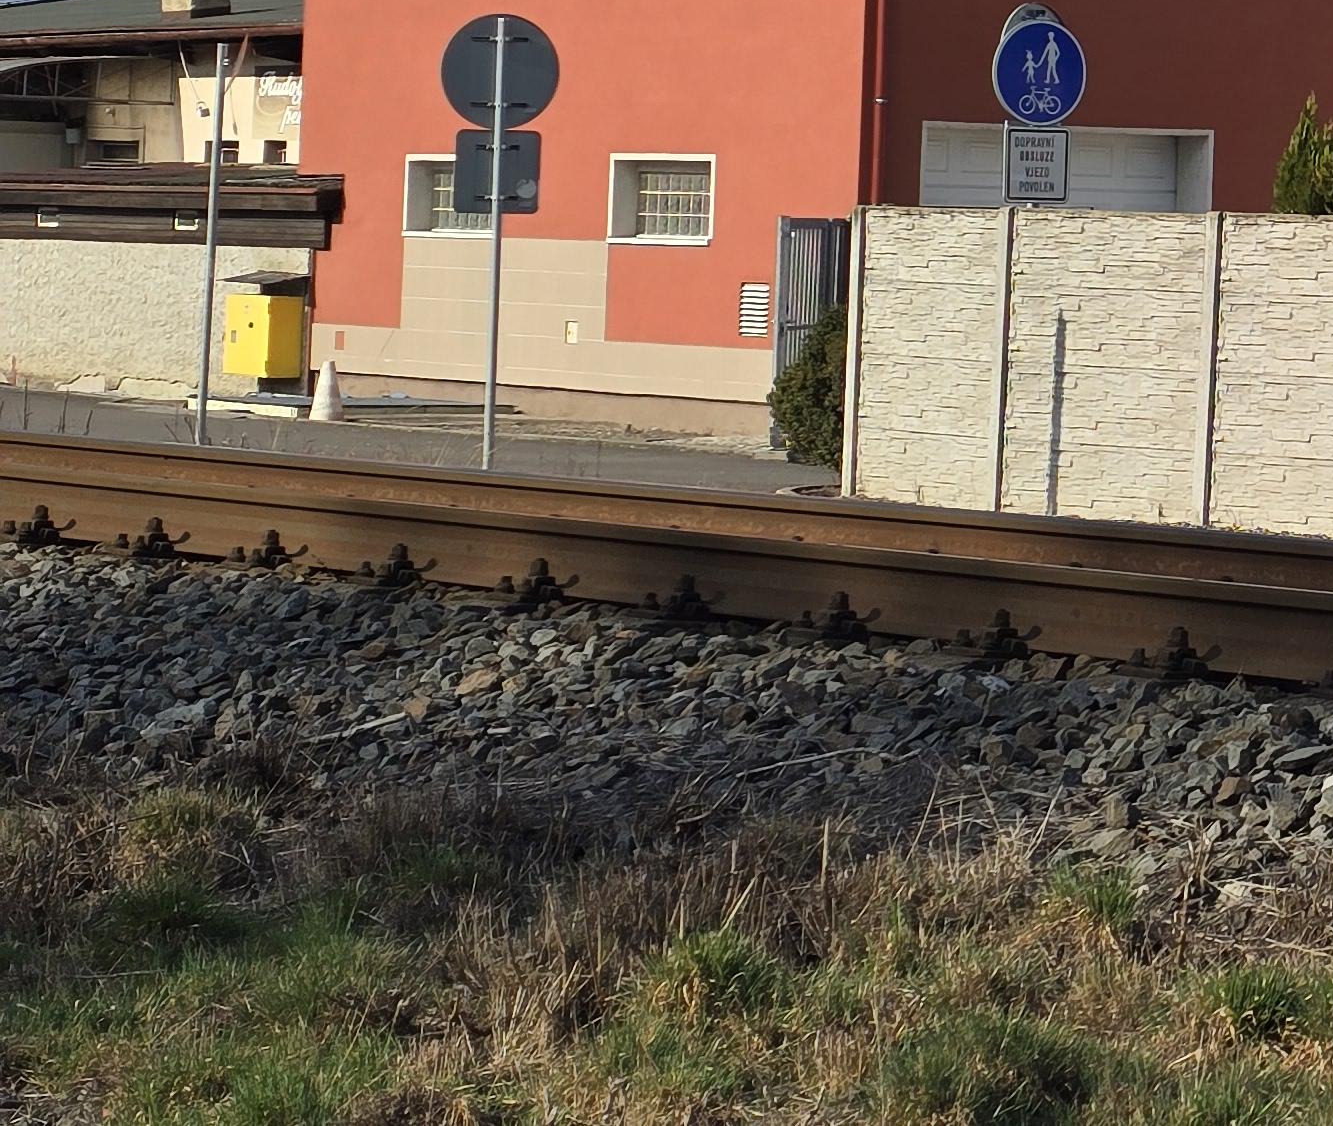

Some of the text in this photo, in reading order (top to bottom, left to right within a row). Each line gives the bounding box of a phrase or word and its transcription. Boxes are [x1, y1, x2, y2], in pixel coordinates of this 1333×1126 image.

[1014, 135, 1056, 148] DOPRAVNÍ
[1025, 166, 1050, 178] VJEZD
[1019, 180, 1055, 193] POVOLEN
